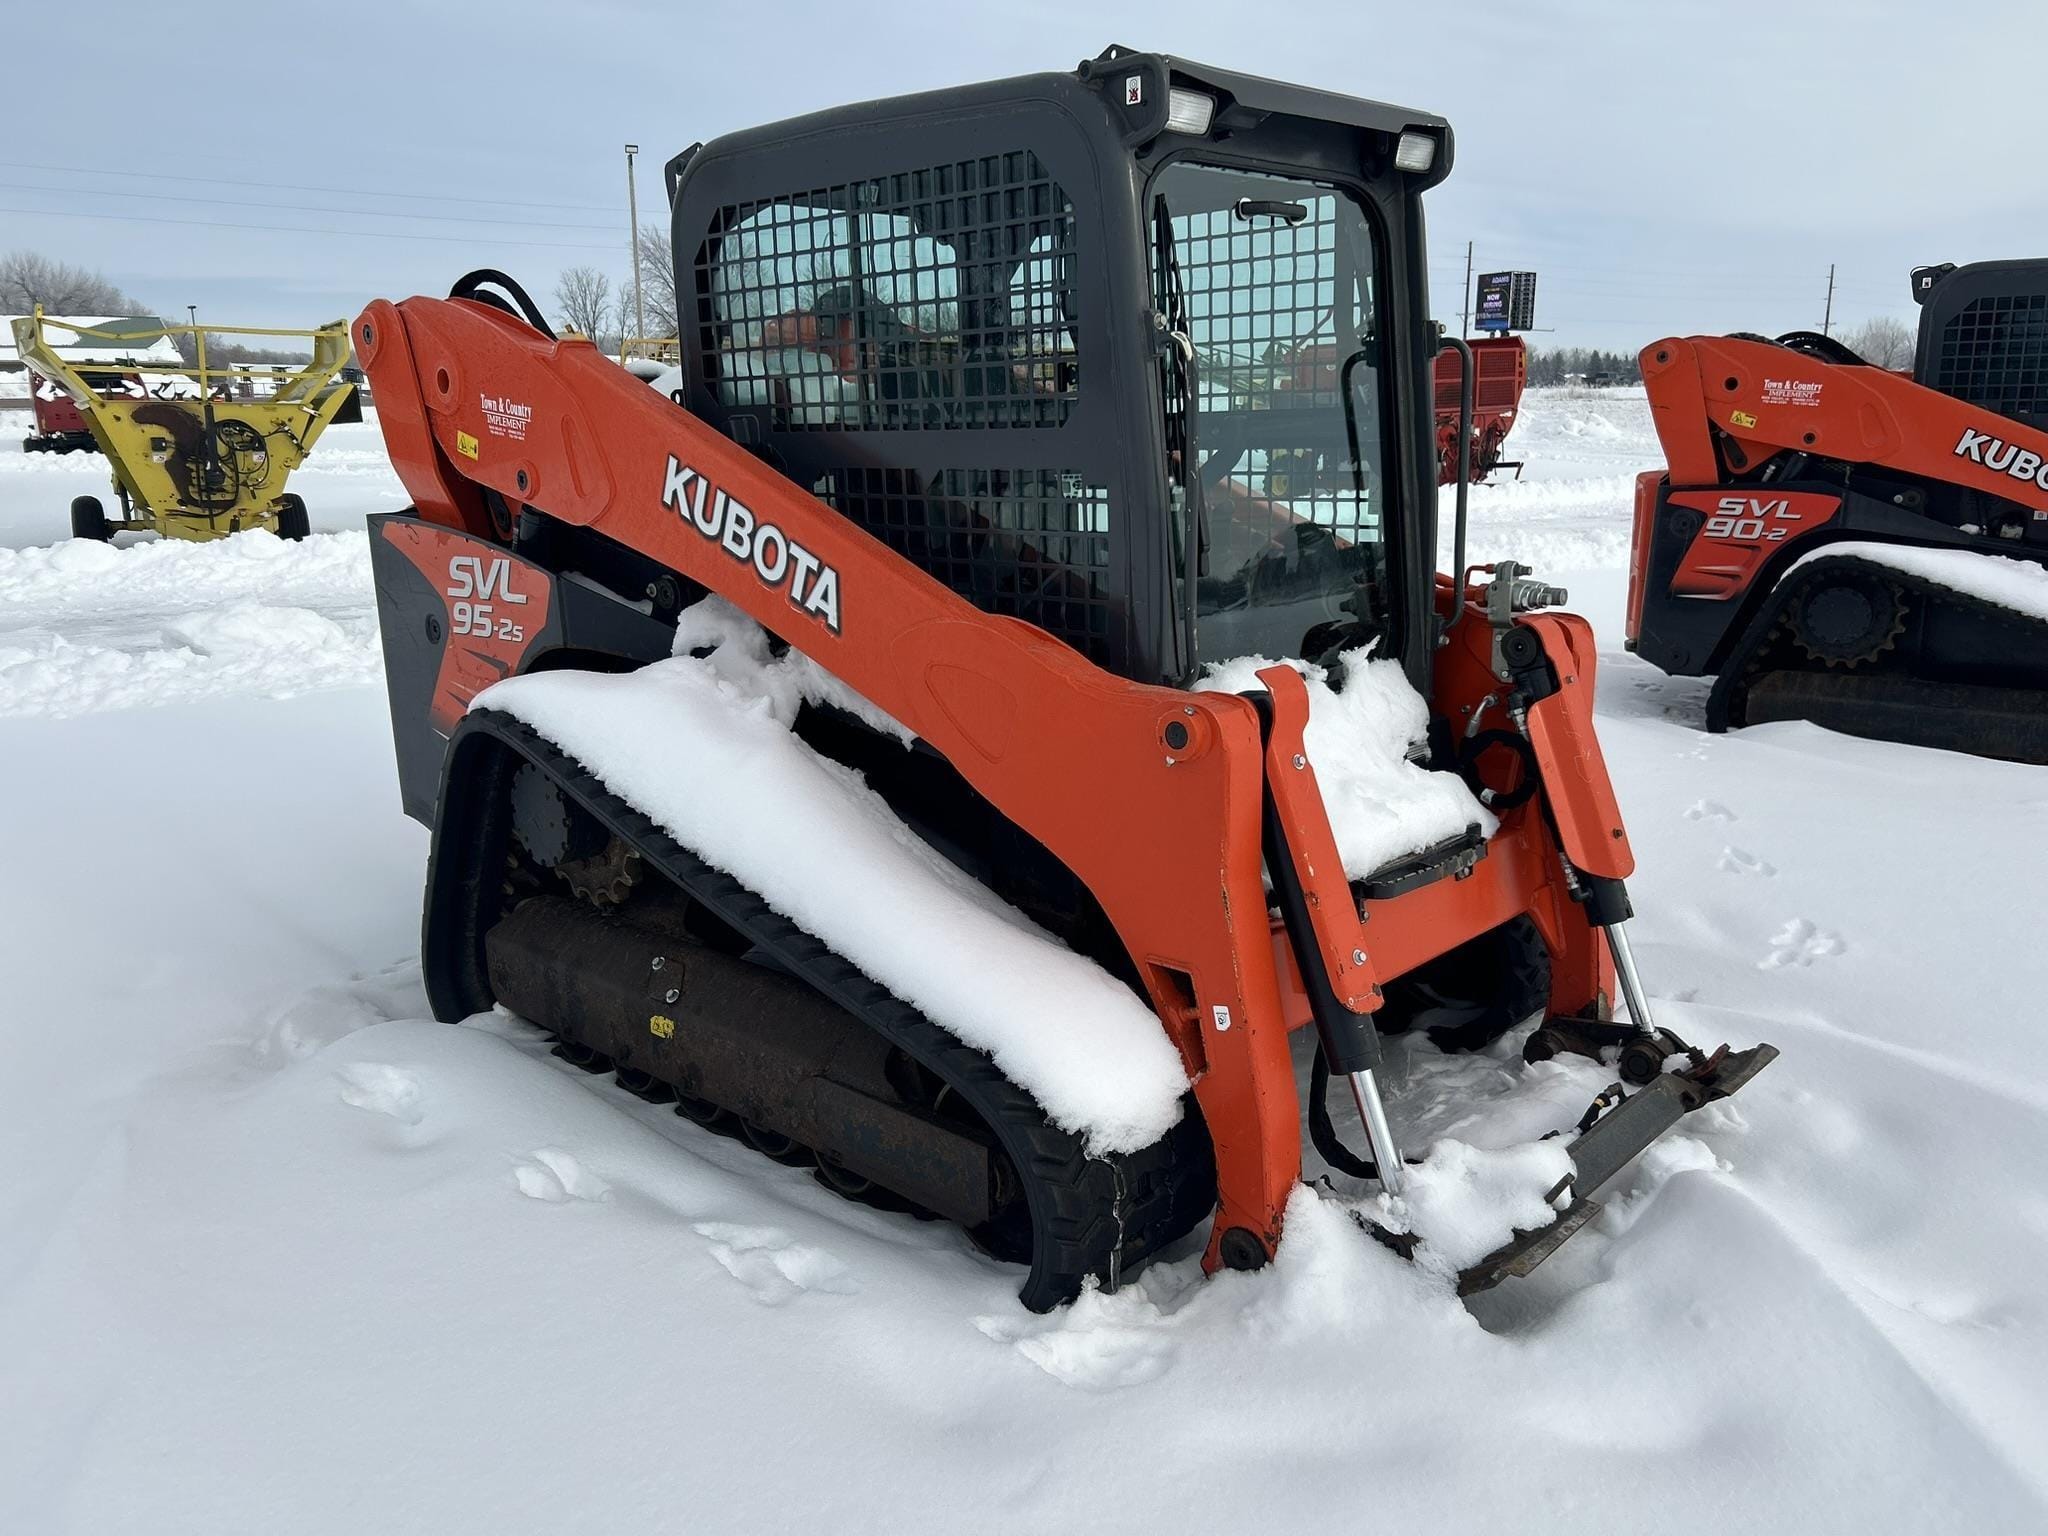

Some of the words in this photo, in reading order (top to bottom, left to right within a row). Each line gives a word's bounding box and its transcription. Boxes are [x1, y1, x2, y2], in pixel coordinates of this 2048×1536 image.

[1483, 301, 1503, 309] HIRING
[1764, 379, 1783, 389] Town
[1784, 380, 1791, 389] &
[1792, 381, 1823, 393] Country
[1768, 389, 1814, 398] IMPLEMENT
[480, 393, 498, 411] Town
[499, 397, 505, 413] &
[505, 398, 532, 422] Country
[486, 413, 527, 431] IMPLEMENT
[1715, 497, 1802, 519] SVL
[1703, 518, 1788, 541] 90-2
[662, 454, 840, 632] KUBOTA
[447, 555, 528, 604] SVL
